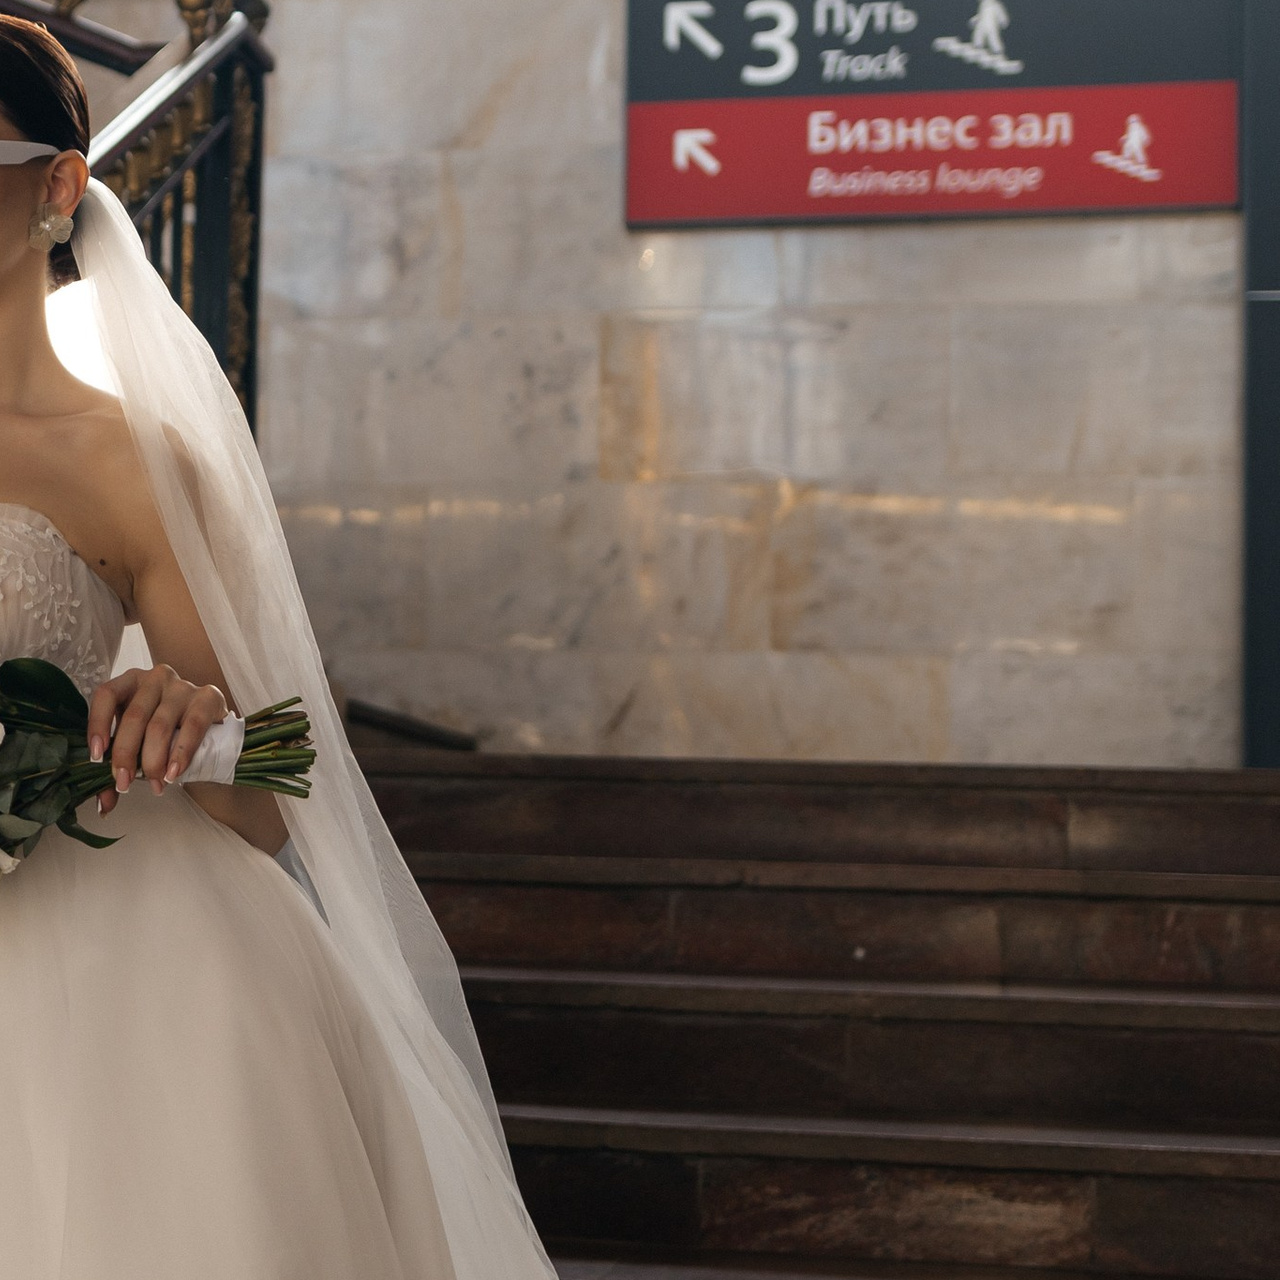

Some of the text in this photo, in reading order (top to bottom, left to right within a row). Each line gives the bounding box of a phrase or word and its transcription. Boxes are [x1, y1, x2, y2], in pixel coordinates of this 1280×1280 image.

[821, 45, 908, 82] Track
[808, 110, 1072, 154] Бизнес зал
[808, 162, 1044, 199] Business lounge
